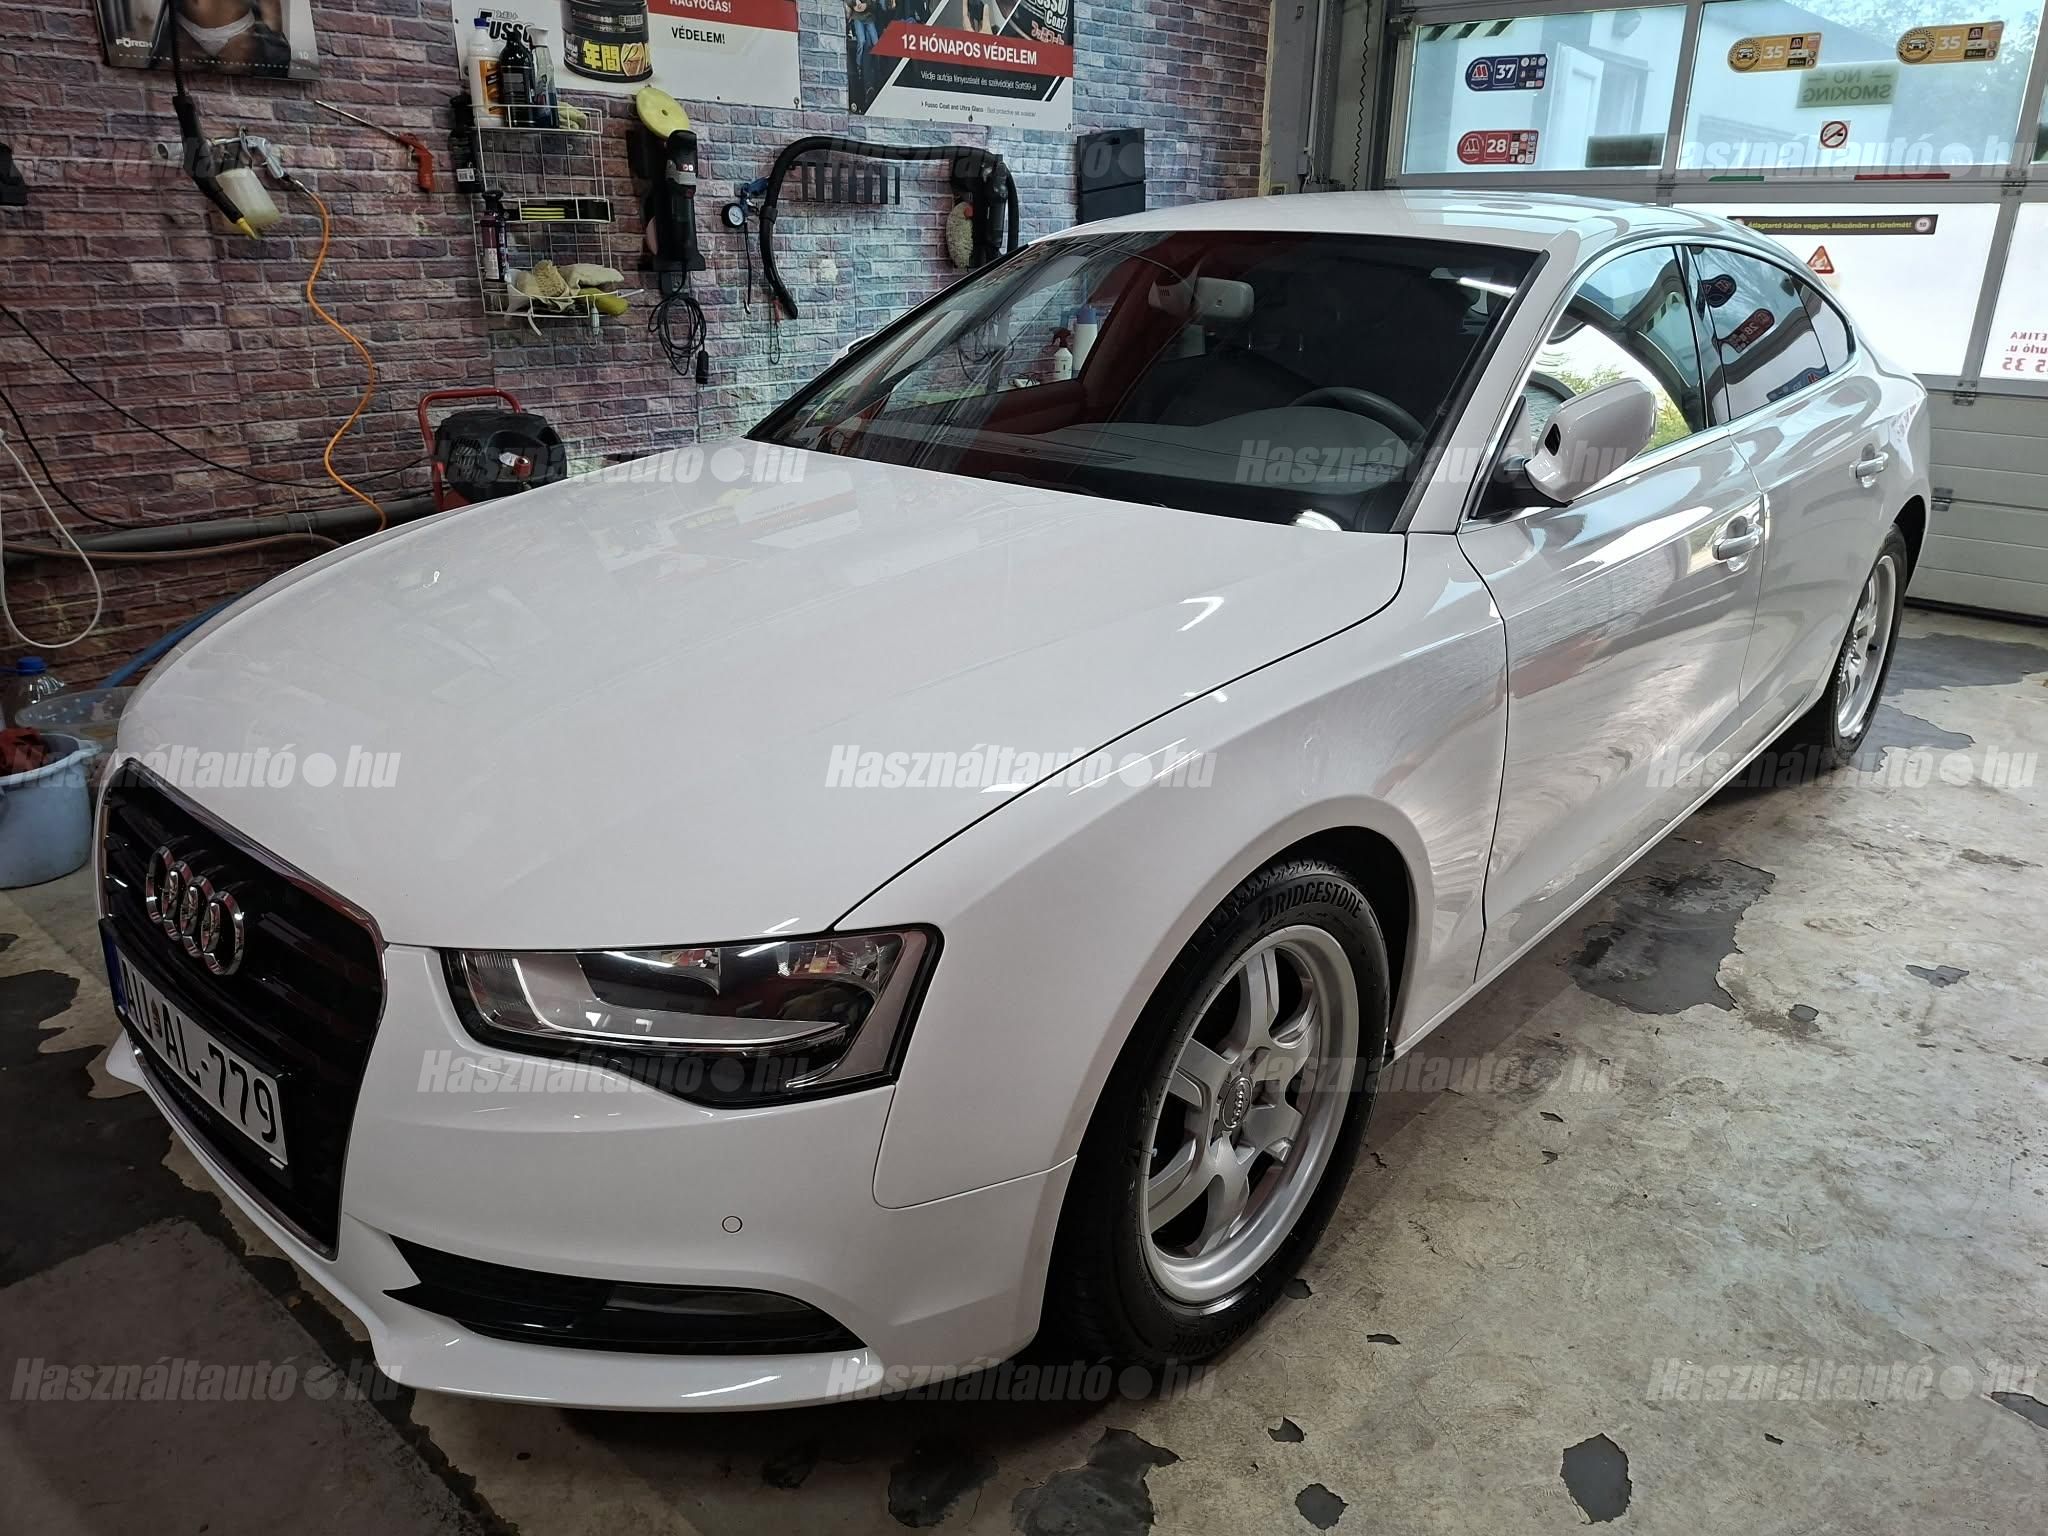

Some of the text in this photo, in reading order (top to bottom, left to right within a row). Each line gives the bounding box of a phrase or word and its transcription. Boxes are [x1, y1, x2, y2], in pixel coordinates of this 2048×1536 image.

[671, 25, 726, 45] VÉDELEM!
[902, 34, 1037, 66] 12 HÓNAPOS VÉDELEM
[1939, 36, 1961, 50] 35
[1763, 45, 1784, 60] 35
[1495, 64, 1516, 79] 37
[1486, 139, 1507, 153] 28
[1258, 881, 1363, 929] BRIDGESTONE
